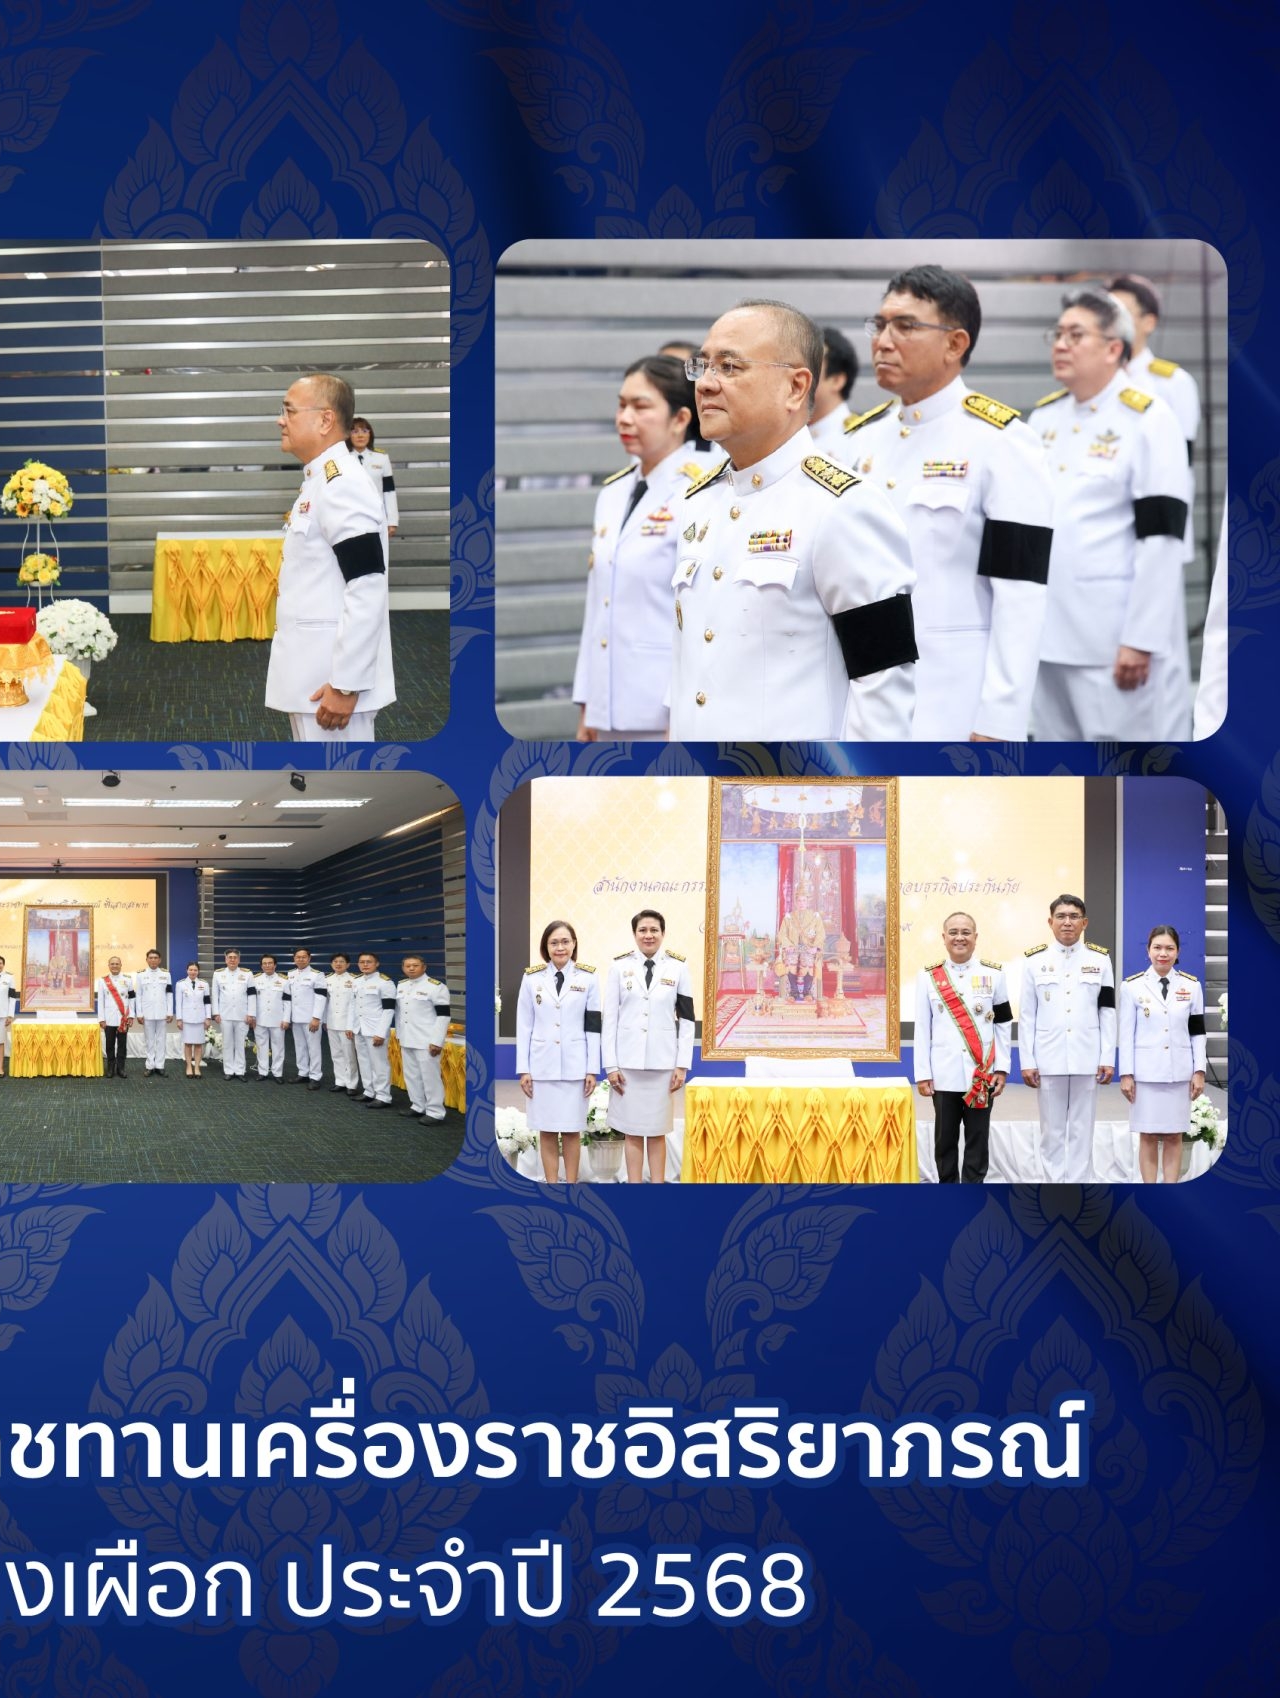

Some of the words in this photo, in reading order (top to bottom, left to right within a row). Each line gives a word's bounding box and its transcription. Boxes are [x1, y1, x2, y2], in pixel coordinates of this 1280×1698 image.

[593, 876, 707, 895] สำนักงานคณะกรร
